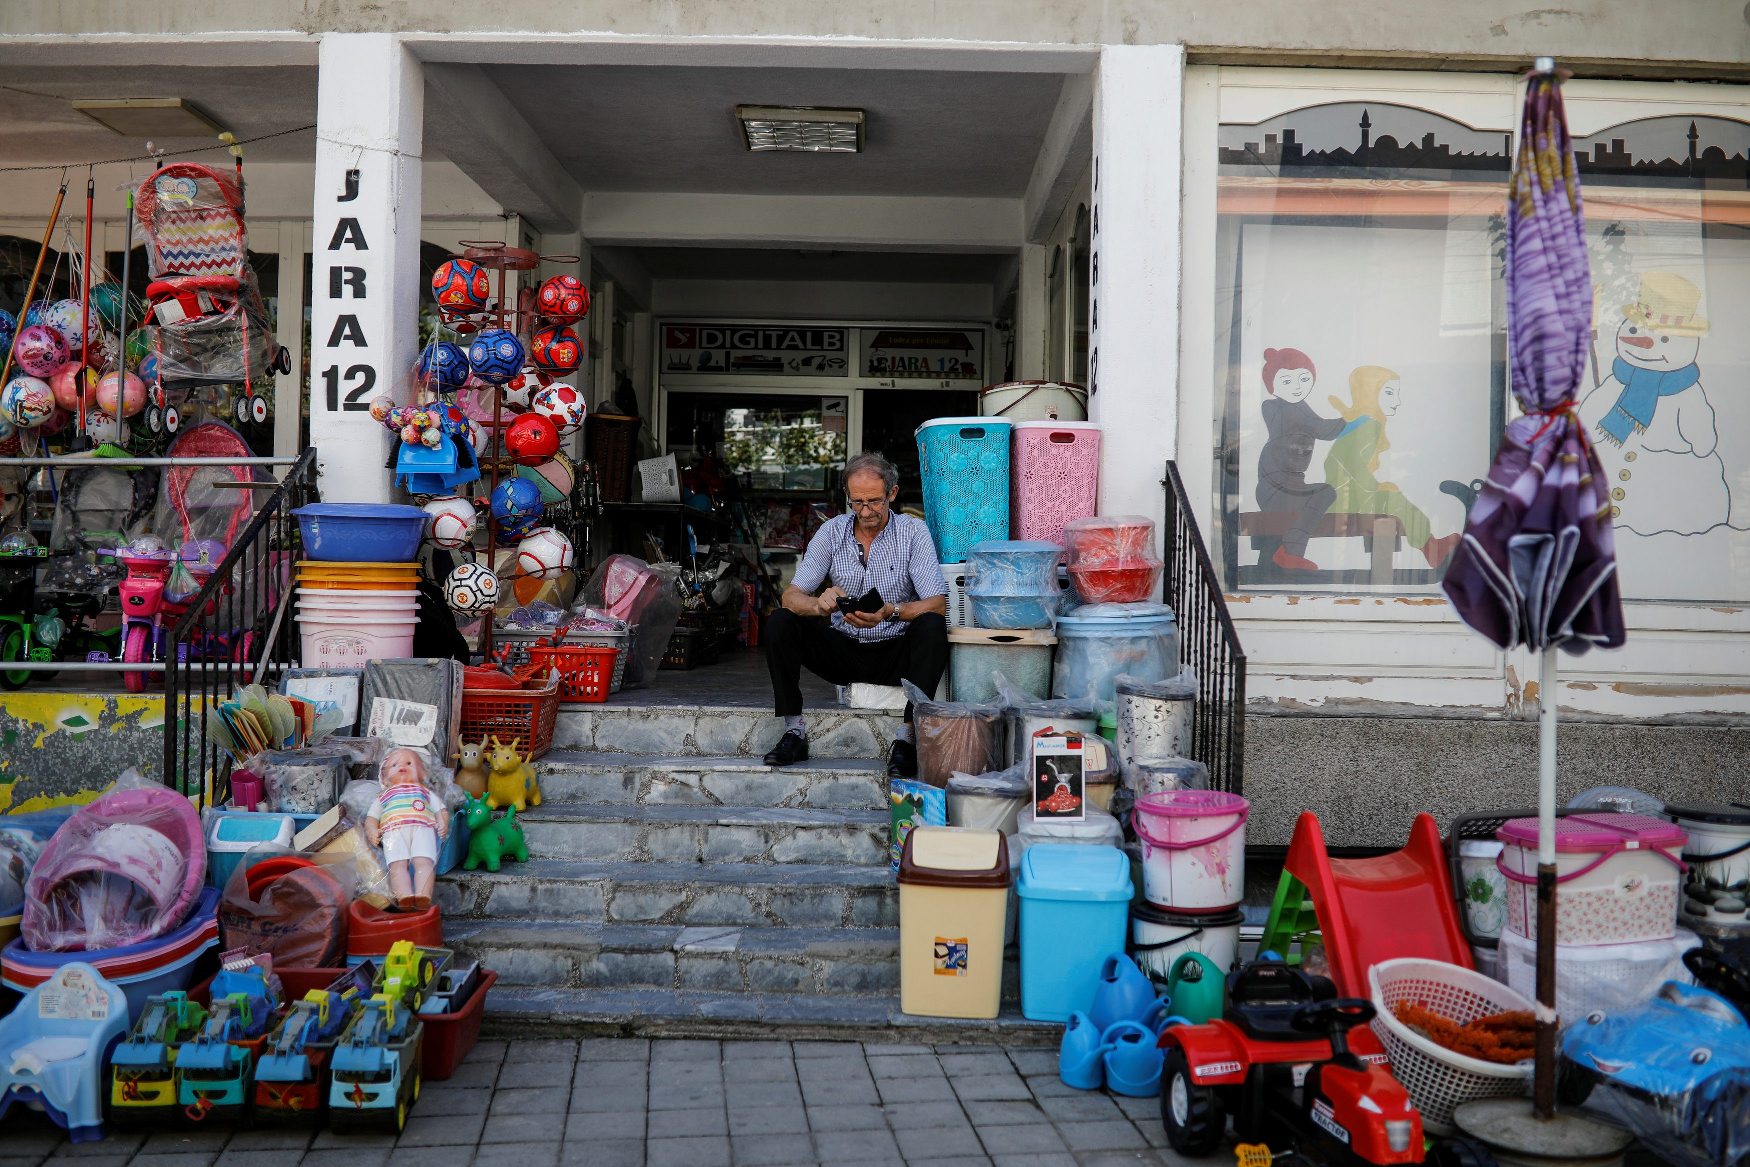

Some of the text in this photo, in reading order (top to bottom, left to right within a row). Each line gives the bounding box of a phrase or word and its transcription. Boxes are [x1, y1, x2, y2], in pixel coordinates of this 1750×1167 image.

[321, 169, 377, 412] JARA 12
[701, 329, 841, 350] DIGITALB
[888, 356, 931, 372] JARA
